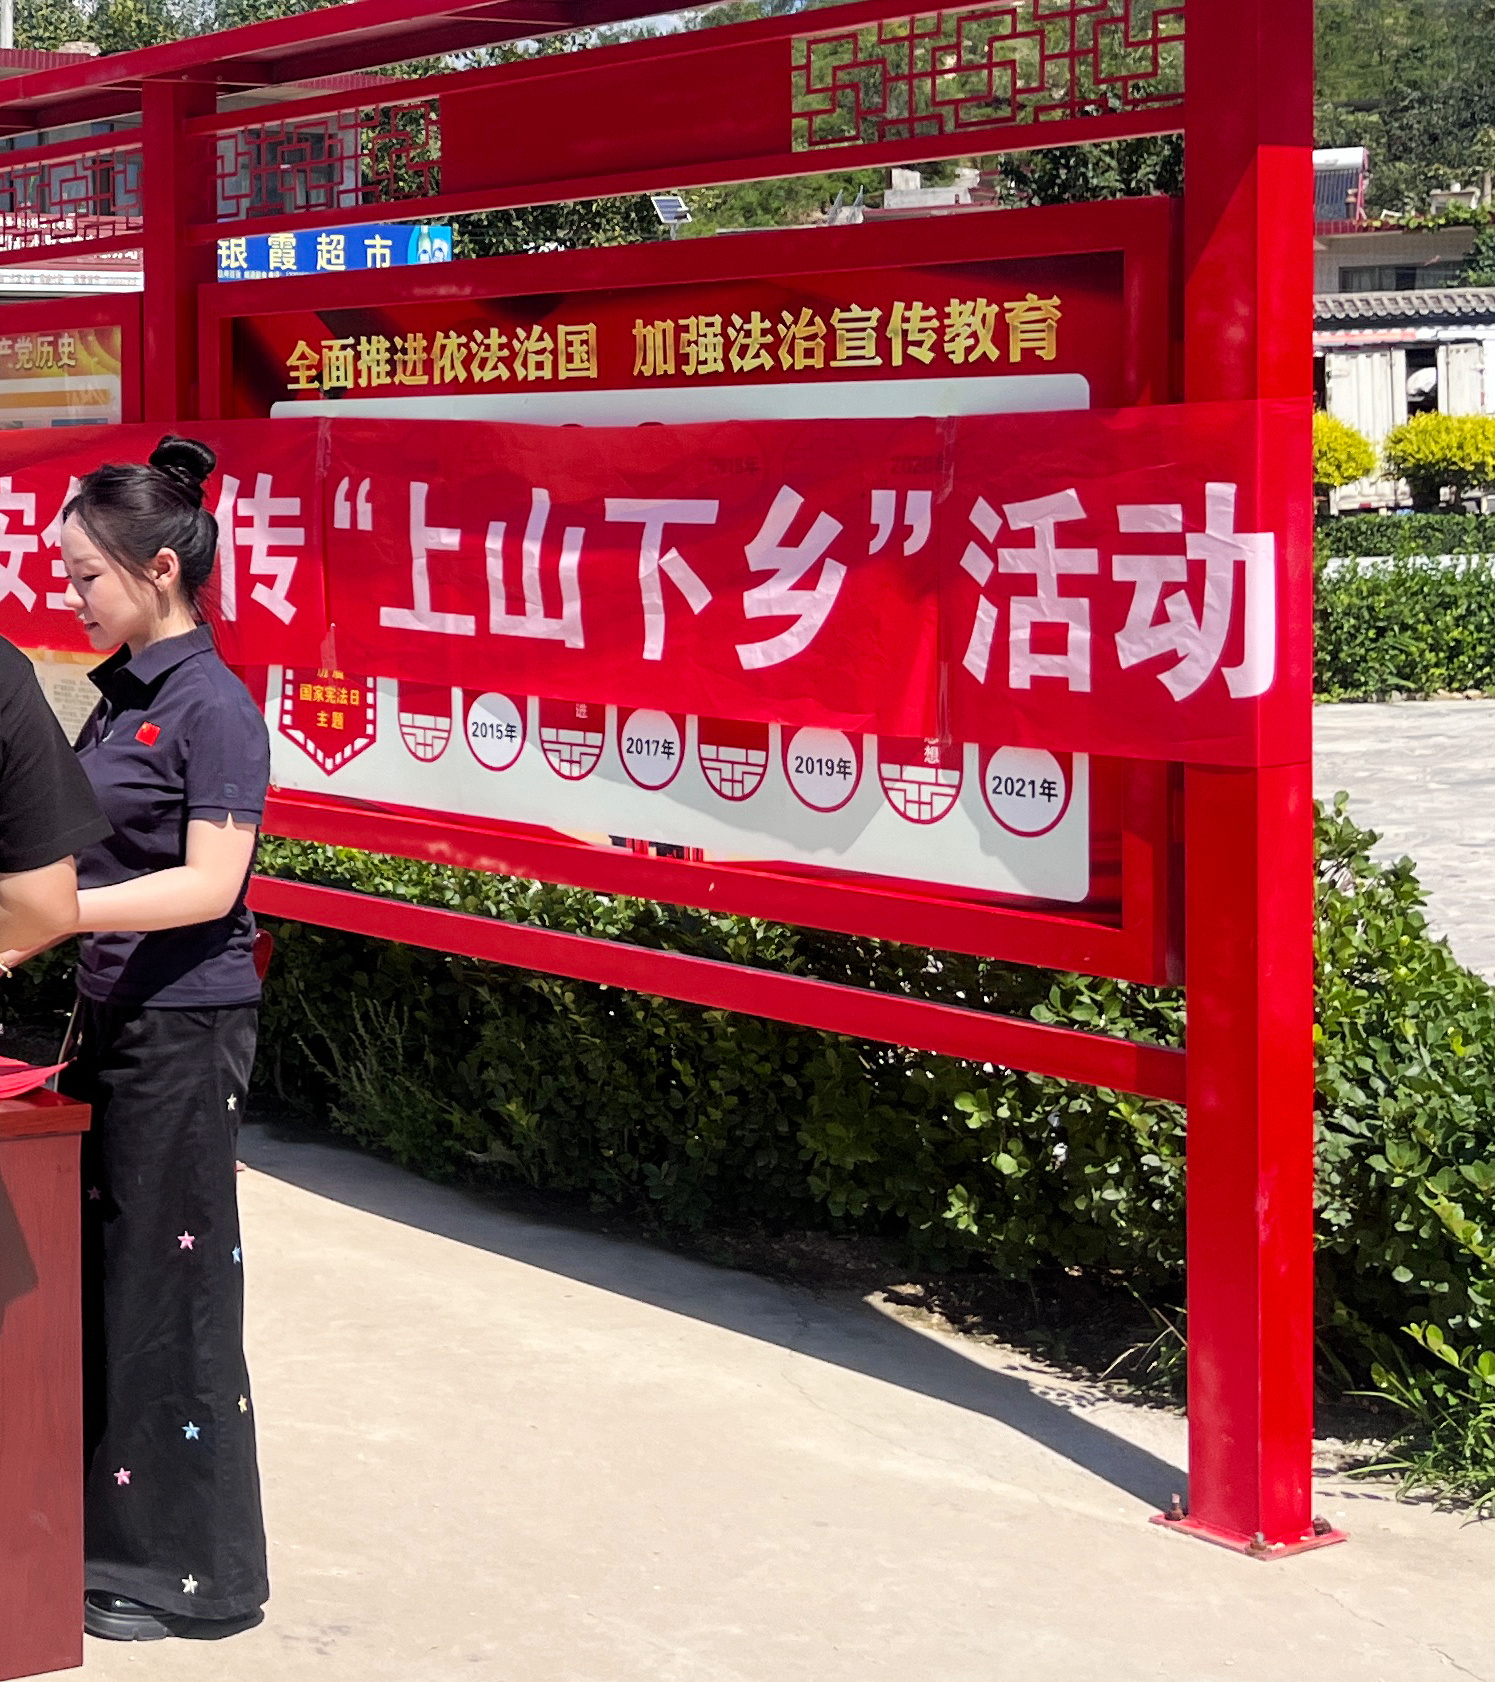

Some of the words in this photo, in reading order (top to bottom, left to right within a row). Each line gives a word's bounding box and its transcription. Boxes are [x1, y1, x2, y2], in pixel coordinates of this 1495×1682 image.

[285, 322, 599, 390] 全面推进依法治国
[631, 293, 1063, 377] 加强法治宣传教育
[299, 683, 360, 706] 国家宪法日
[316, 710, 344, 731] 主题
[471, 721, 518, 743] 2015年
[626, 736, 676, 760] 2017年
[794, 754, 853, 780] 2019年
[991, 775, 1059, 803] 2021年
